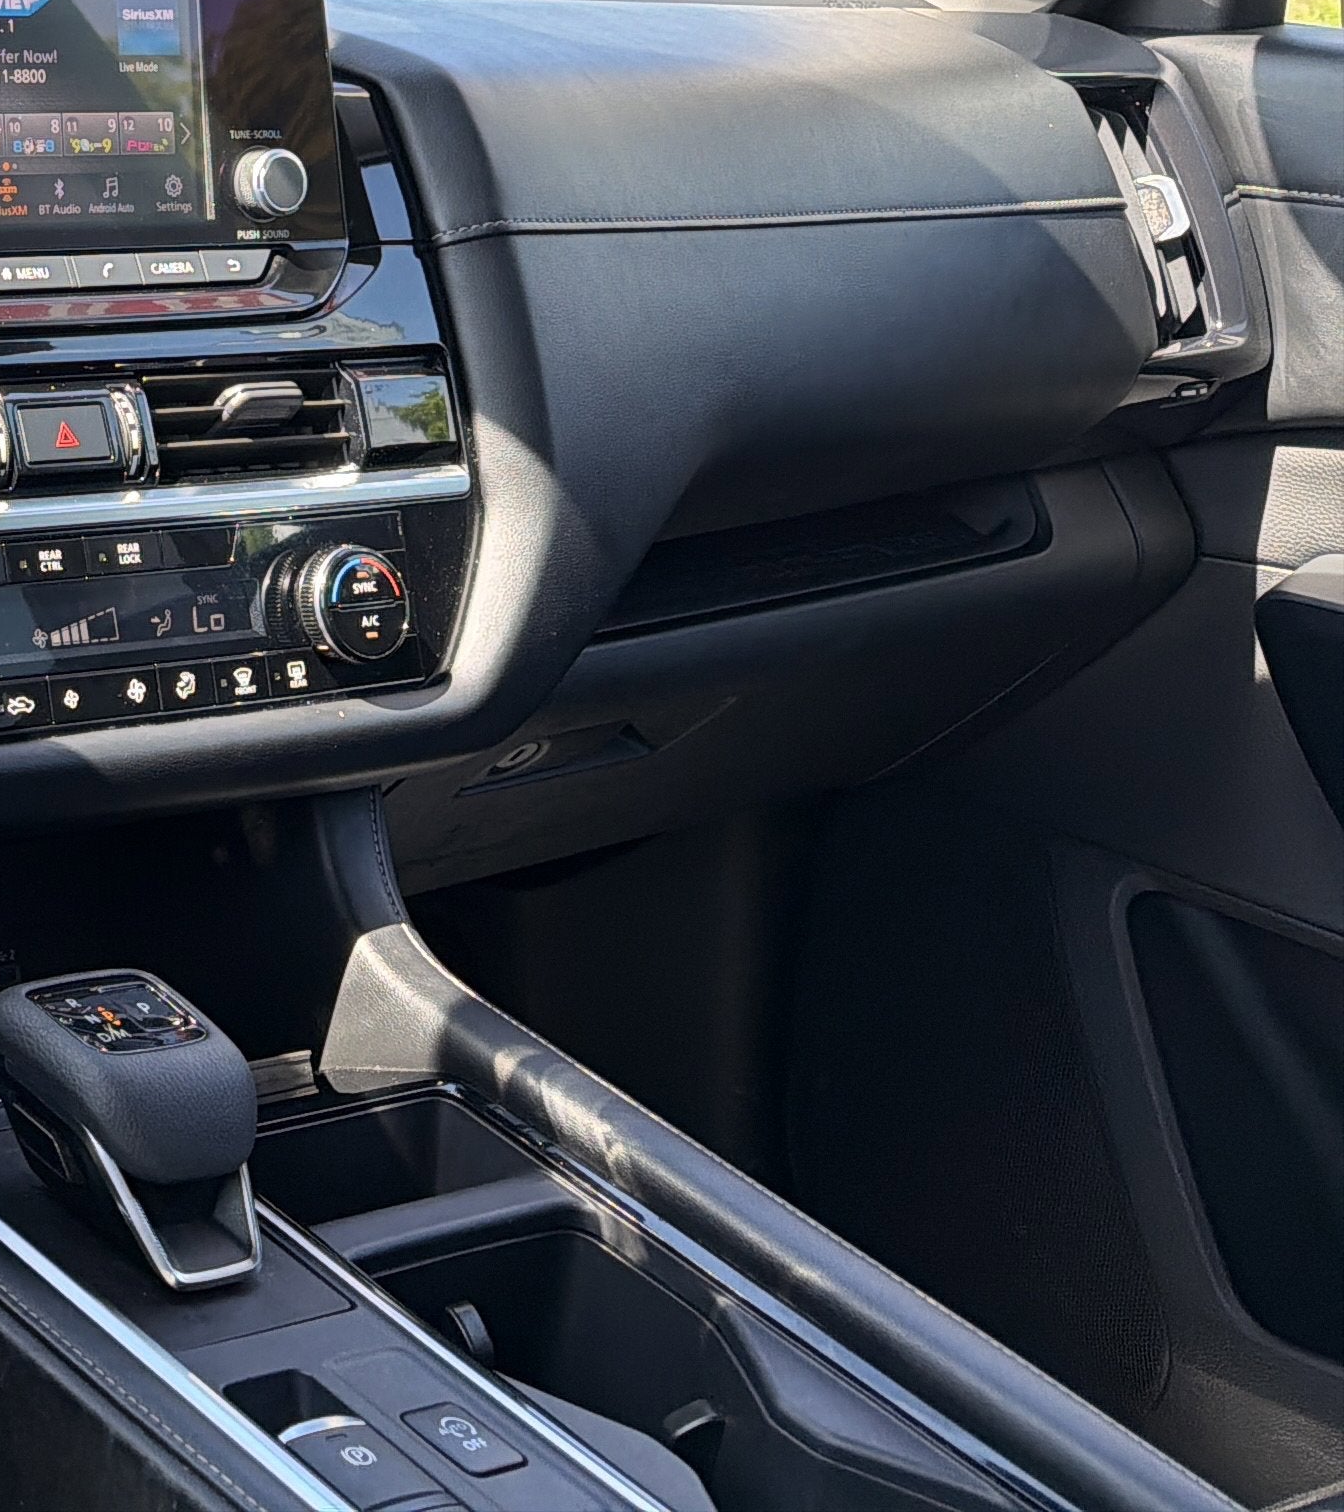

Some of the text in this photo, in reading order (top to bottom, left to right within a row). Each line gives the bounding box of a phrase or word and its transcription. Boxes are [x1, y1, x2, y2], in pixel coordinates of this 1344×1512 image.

[8, 19, 14, 33] 1
[23, 49, 58, 64] Now!
[119, 62, 158, 73] Live Mode
[9, 122, 21, 133] 10
[50, 119, 60, 134] 8
[66, 121, 78, 132] 11
[107, 118, 116, 133] 9
[123, 120, 135, 131] 12
[157, 117, 173, 133] 10
[38, 204, 81, 215] BT Audio
[88, 203, 134, 214] Android Auto
[156, 201, 193, 214] Settings
[237, 229, 290, 239] PUSH SOUND
[16, 267, 50, 280] MENU
[150, 261, 194, 275] CAMERA
[117, 542, 140, 555] REAR
[38, 549, 62, 561] REAR
[119, 553, 142, 565] LOCK
[40, 560, 63, 573] CTRL
[352, 580, 378, 595] SYNC
[197, 593, 219, 605] SYNC
[193, 606, 225, 633] Lo
[361, 614, 380, 627] A/C
[290, 678, 308, 688] REAR
[65, 998, 82, 1009] R
[136, 1002, 151, 1014] P
[84, 1014, 102, 1025] N
[97, 1024, 132, 1043] D/M
